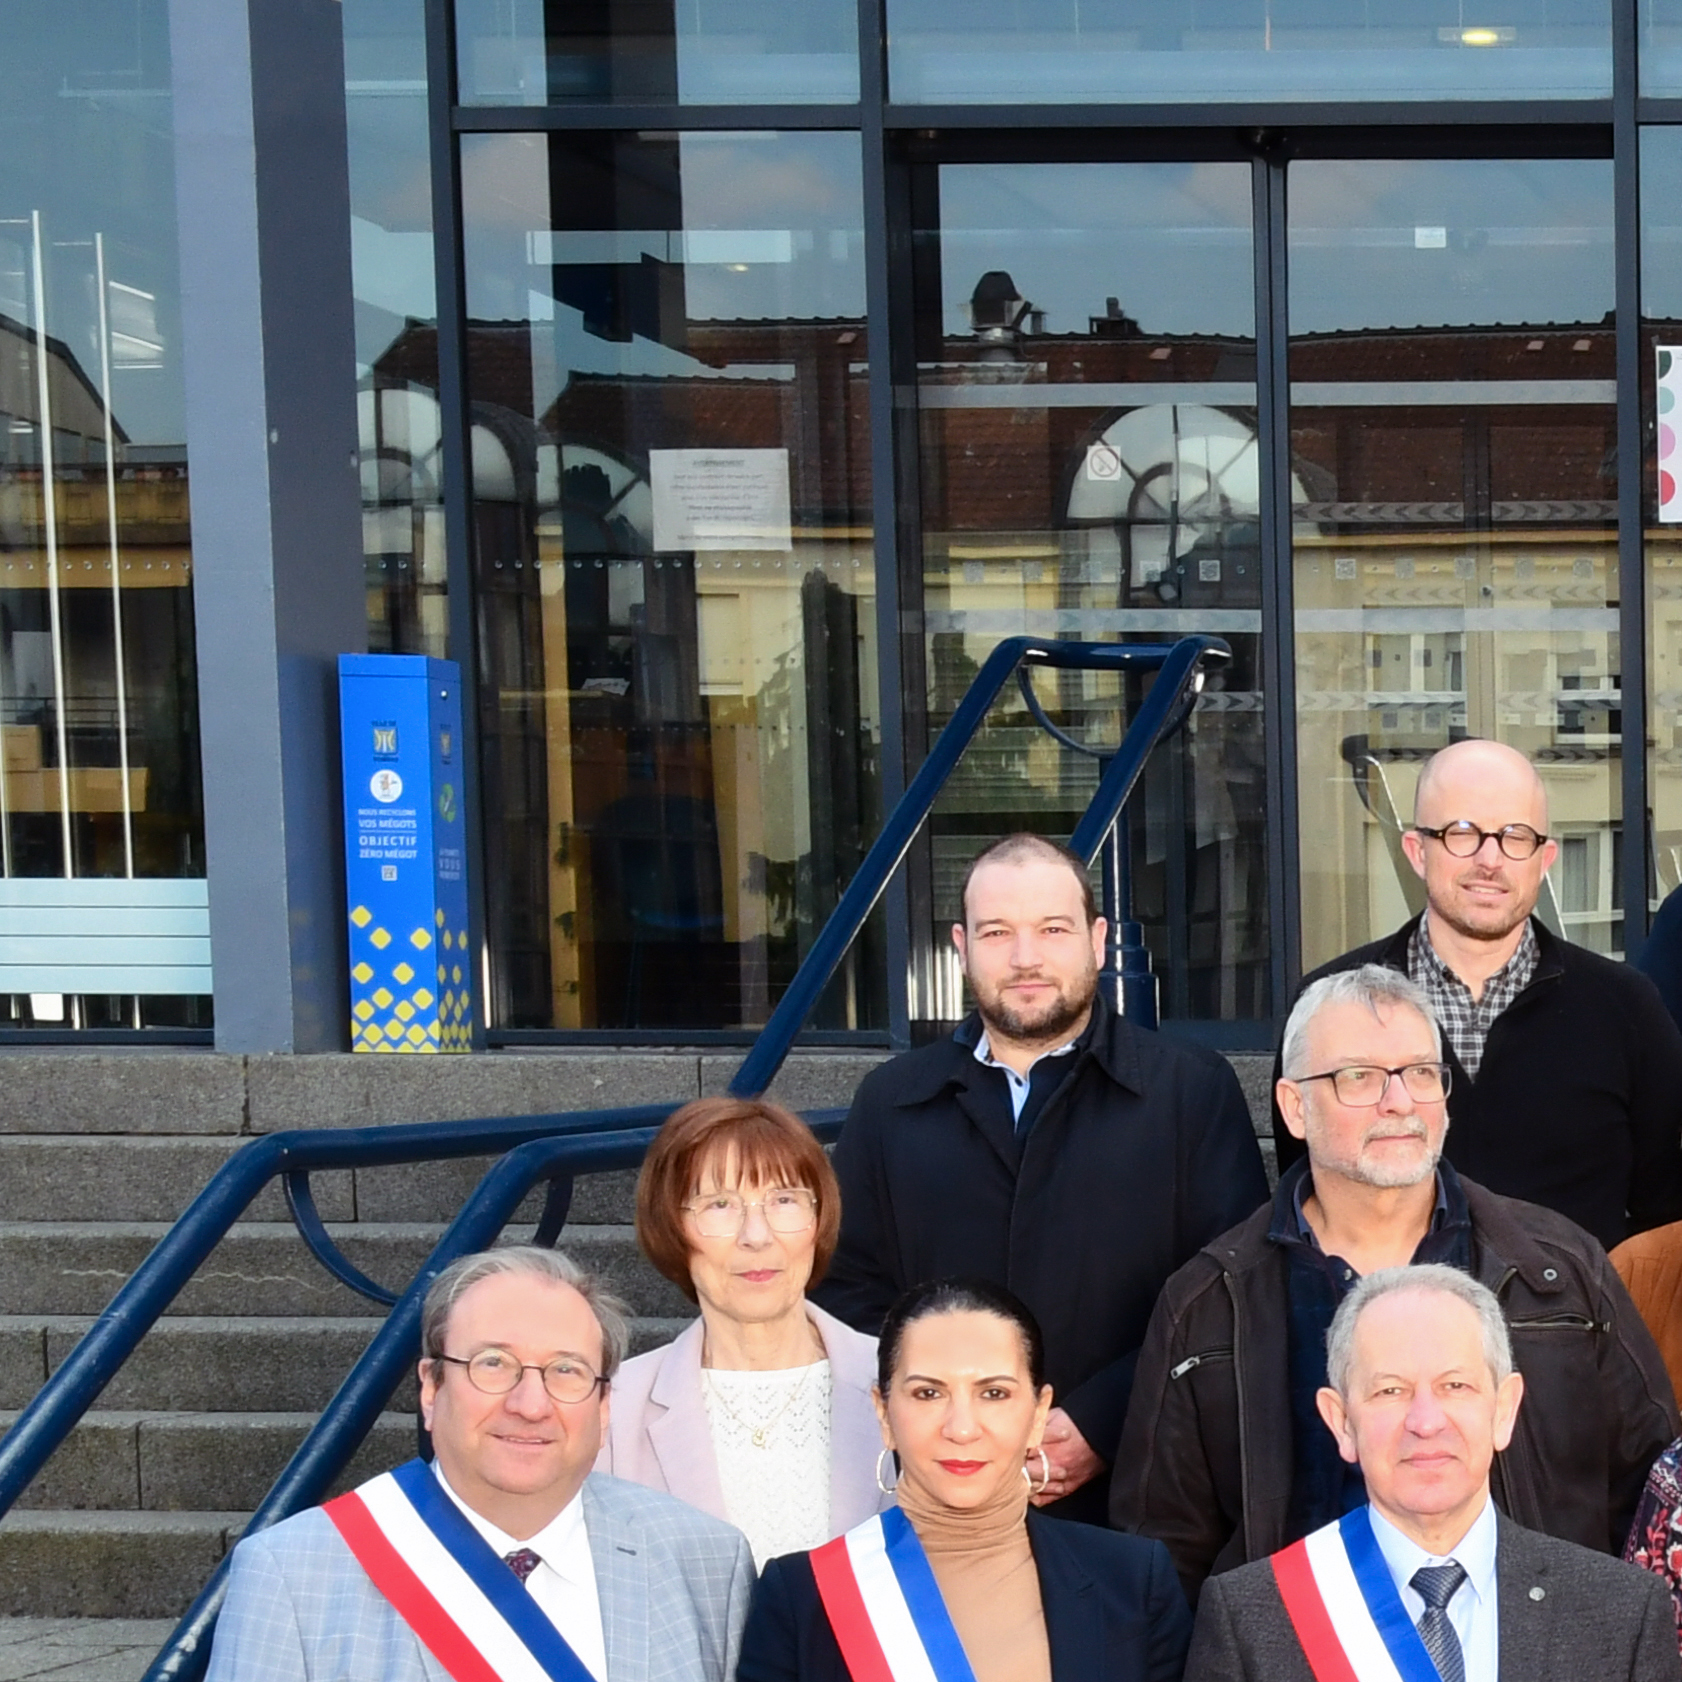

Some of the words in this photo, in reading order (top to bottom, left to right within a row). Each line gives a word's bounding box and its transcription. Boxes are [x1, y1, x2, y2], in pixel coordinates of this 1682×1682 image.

[358, 819, 377, 828] VOS
[379, 818, 417, 829] MÉGOTS
[359, 835, 417, 846] OBJECTIF
[359, 848, 383, 858] ZÉRO
[384, 848, 418, 858] MÉGOT
